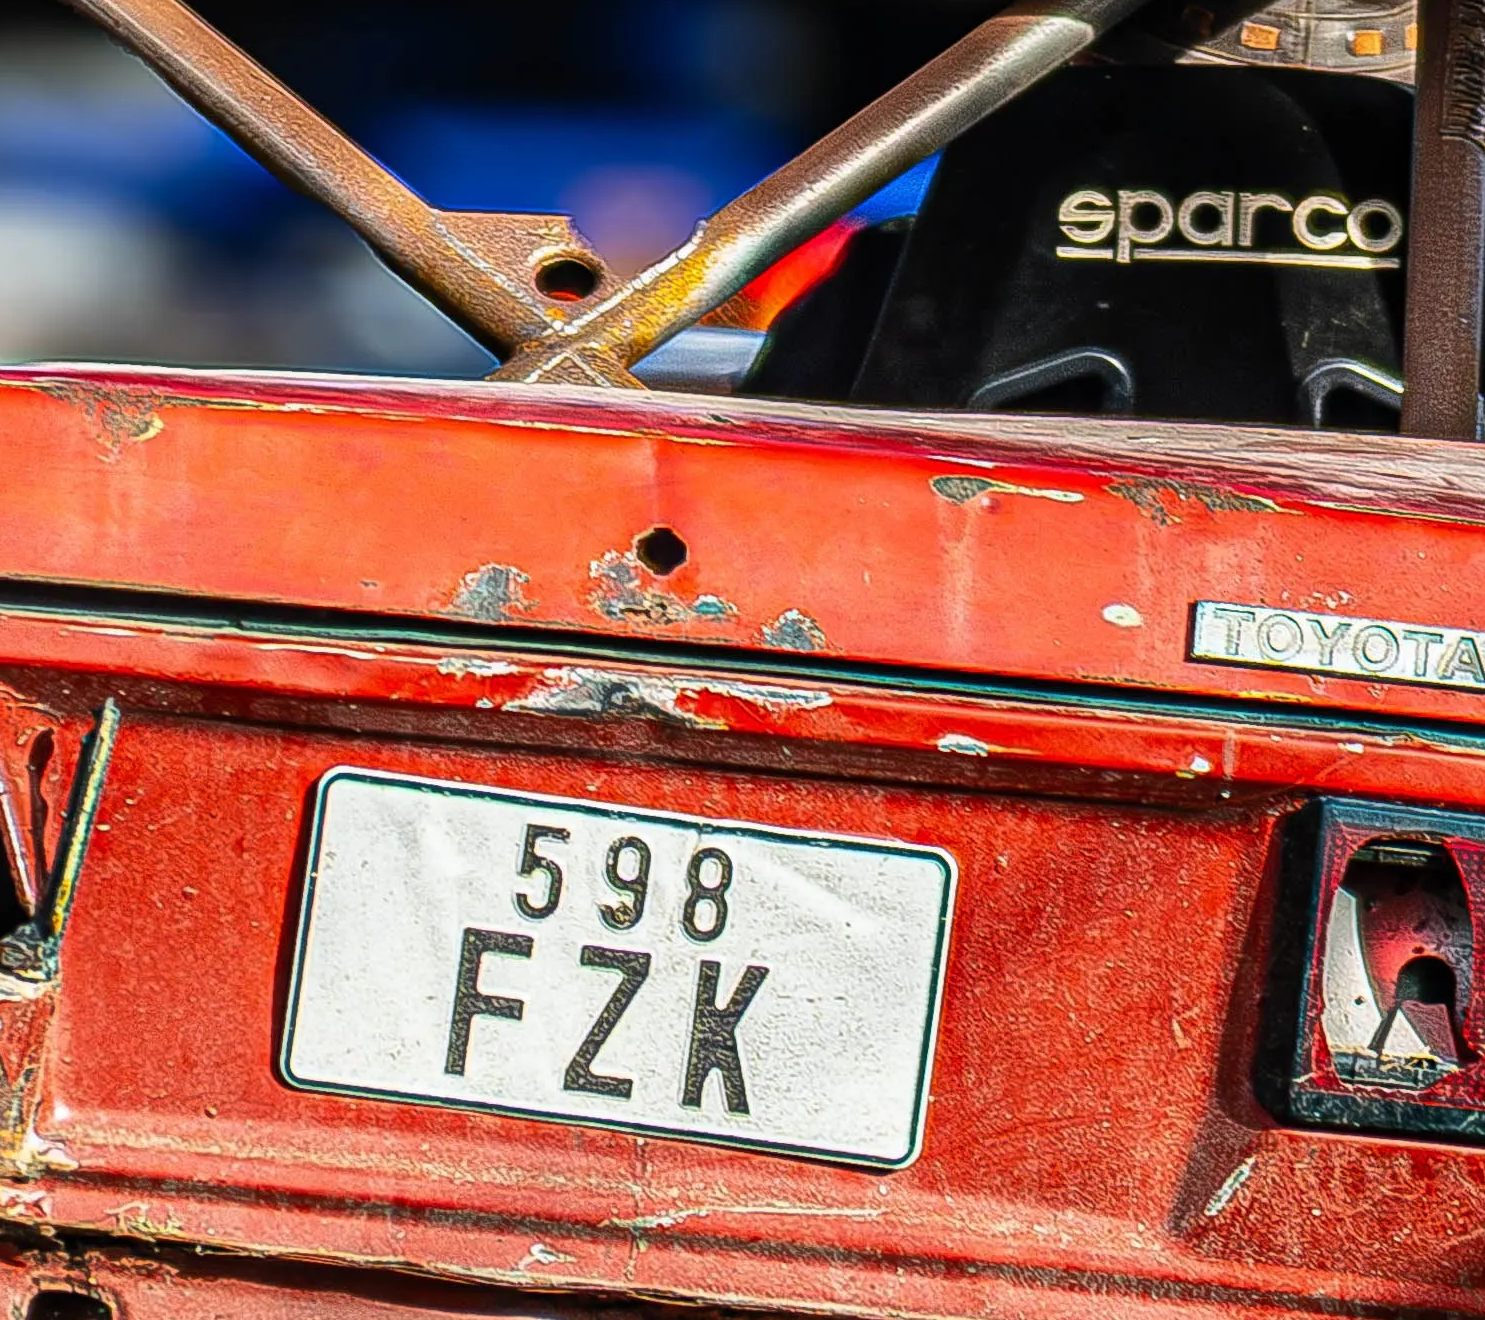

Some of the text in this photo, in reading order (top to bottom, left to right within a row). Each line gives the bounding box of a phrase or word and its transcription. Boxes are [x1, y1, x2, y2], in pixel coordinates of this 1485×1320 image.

[1058, 190, 1404, 264] sparco
[510, 822, 734, 943] 598
[443, 926, 771, 1116] FZK
